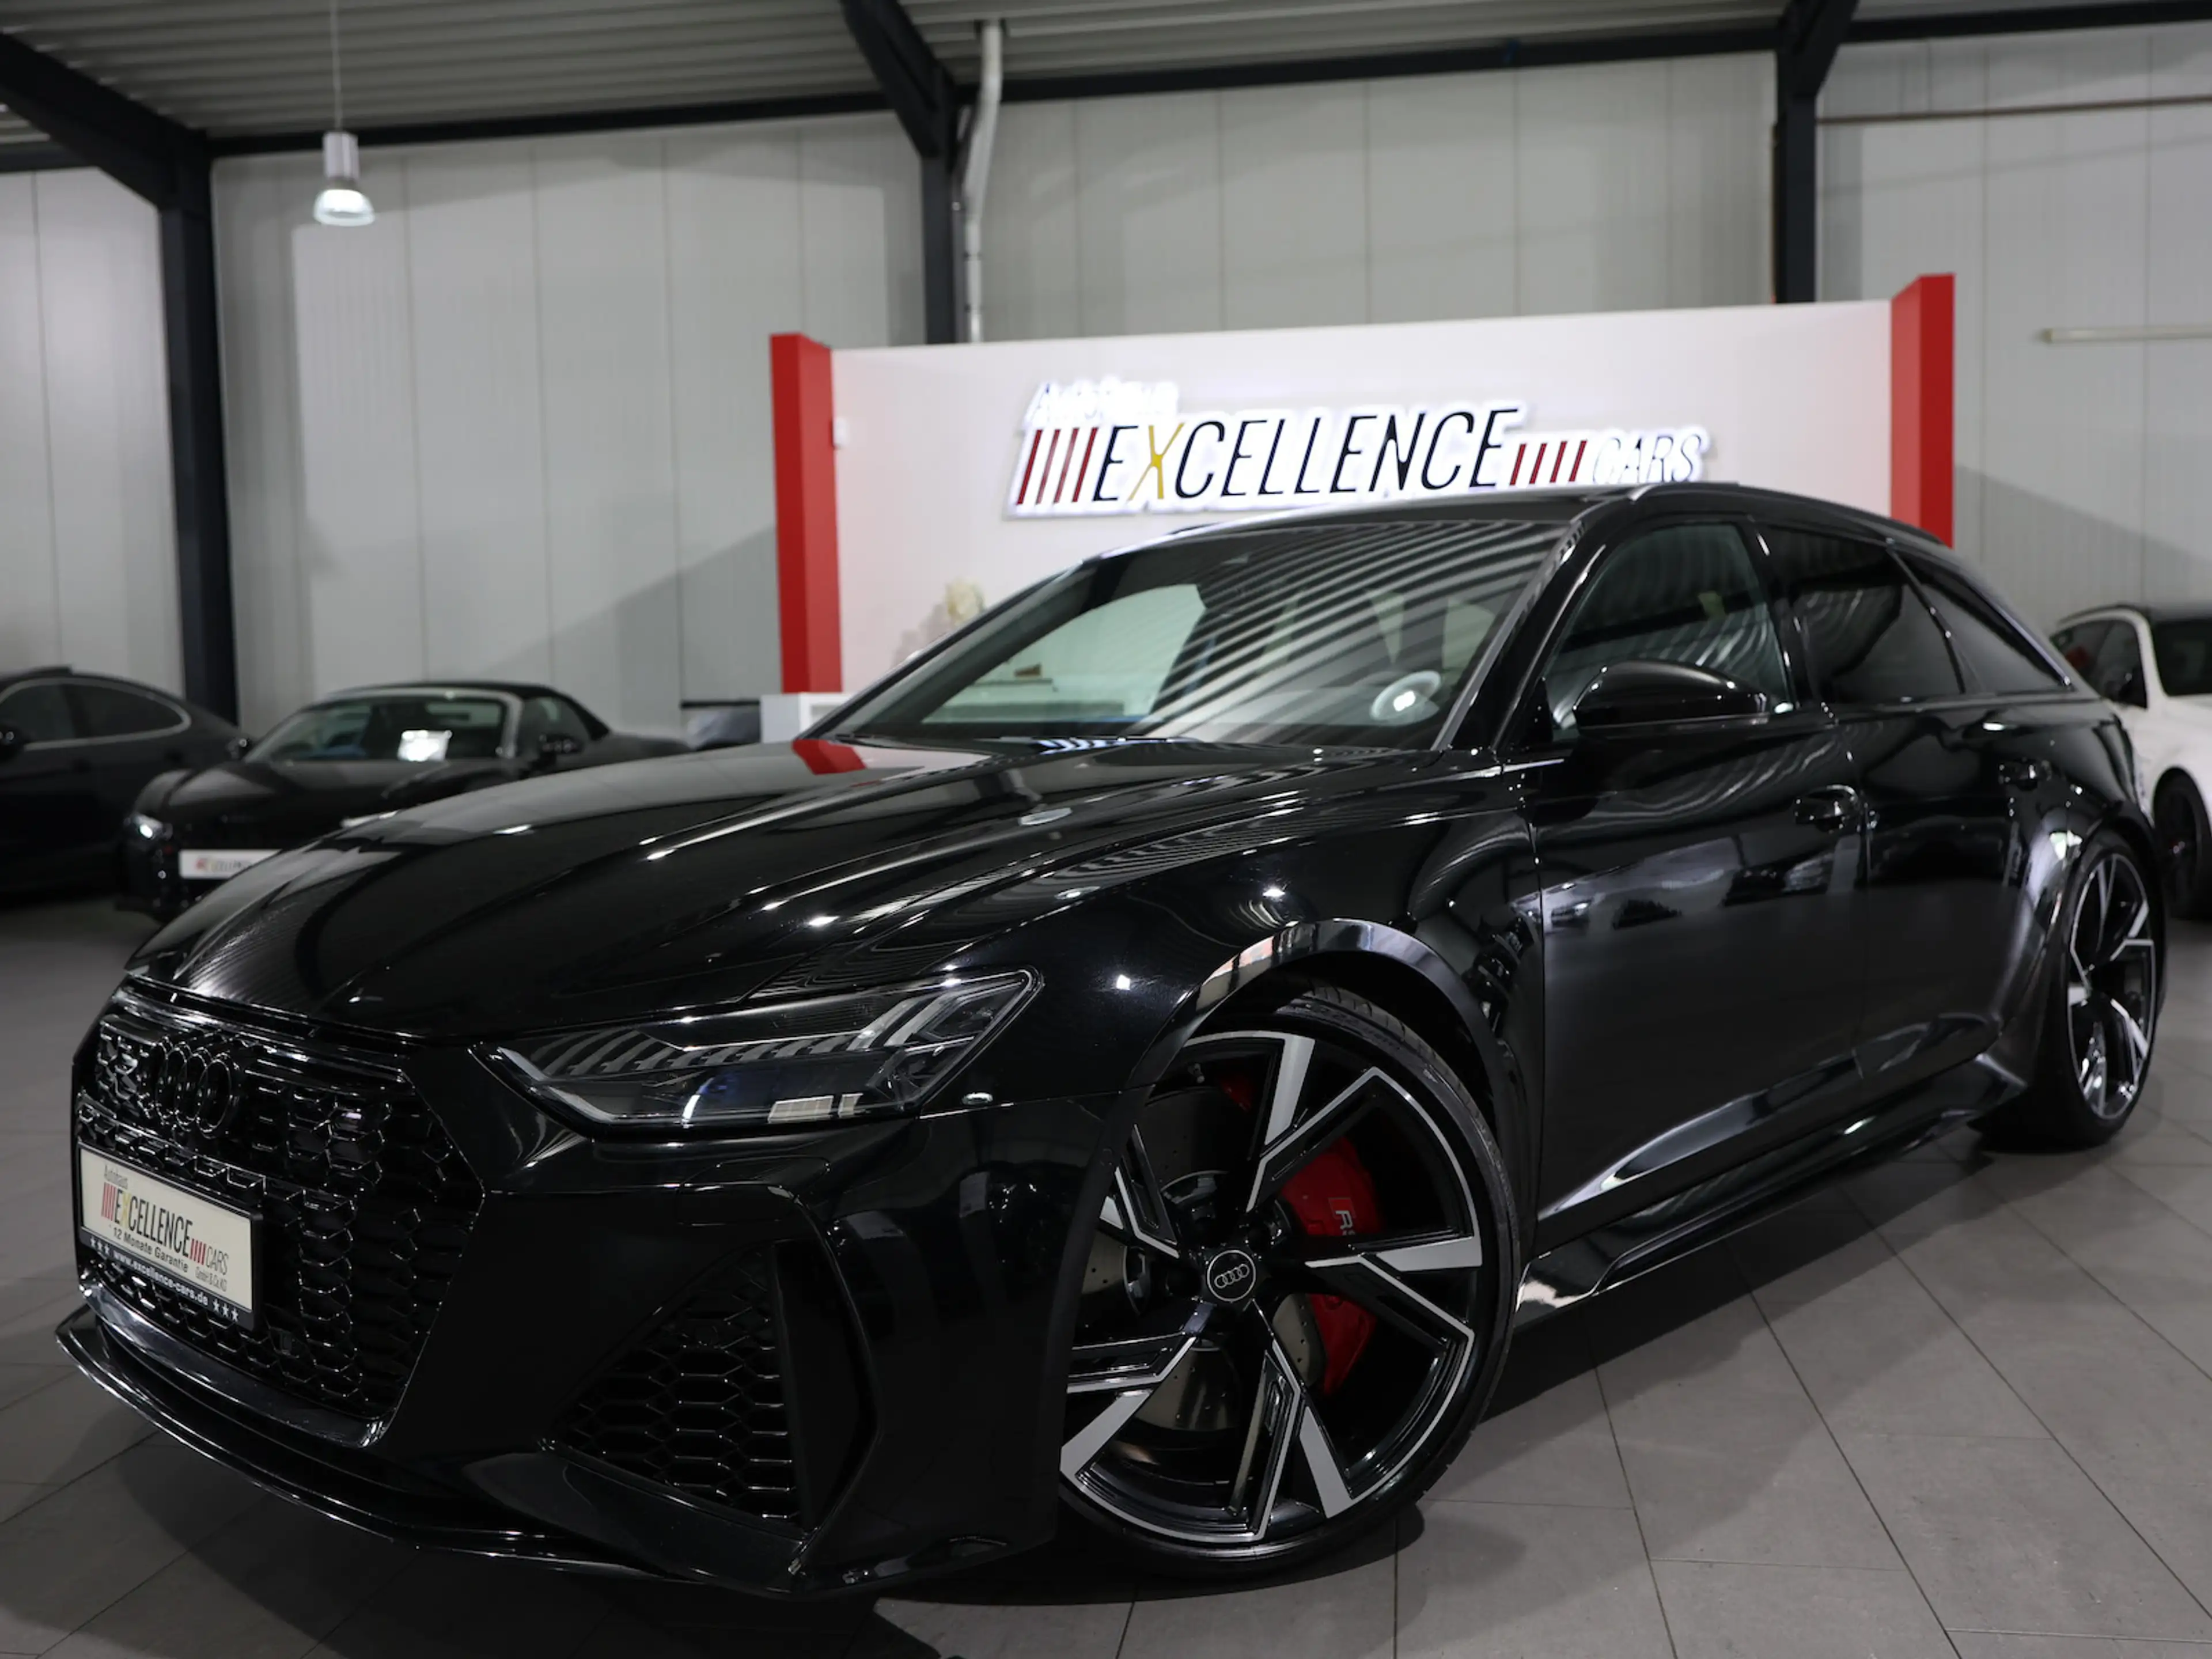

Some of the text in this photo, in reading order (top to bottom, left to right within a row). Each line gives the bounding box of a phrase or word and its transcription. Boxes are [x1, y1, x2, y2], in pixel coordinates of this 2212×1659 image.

[1092, 408, 1702, 502] EXCELLENCE CARS
[113, 1228, 188, 1272] 12 Monate Garantie
[114, 1188, 229, 1275] EXCELLENCE CARS
[113, 1250, 208, 1305] www.excellence-cars.de
